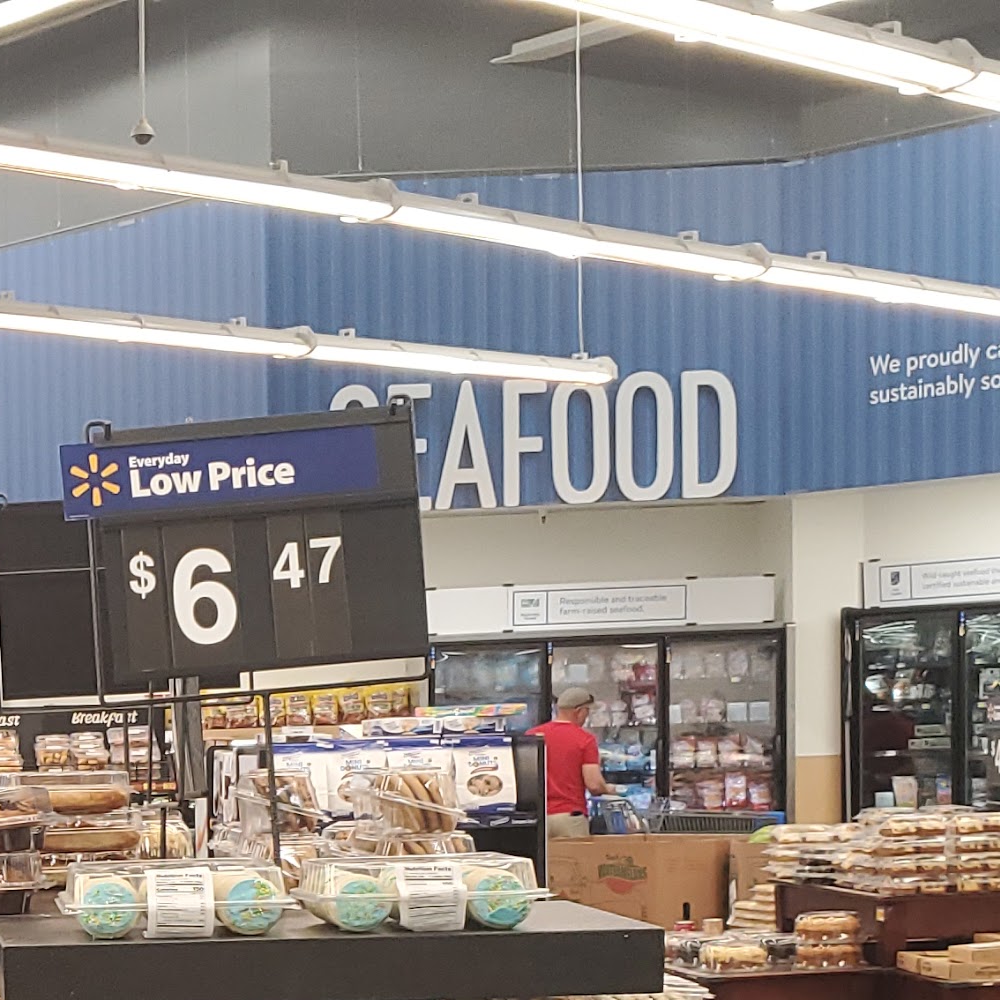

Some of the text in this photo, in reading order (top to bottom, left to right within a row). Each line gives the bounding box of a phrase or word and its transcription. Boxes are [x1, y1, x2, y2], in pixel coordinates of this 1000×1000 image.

[869, 342, 1000, 378] We proudly c
[868, 373, 976, 405] sustainably
[329, 369, 738, 511] AFOOD
[128, 452, 190, 469] Everyday
[129, 456, 296, 499] Low Price
[71, 710, 139, 728] Breakfat
